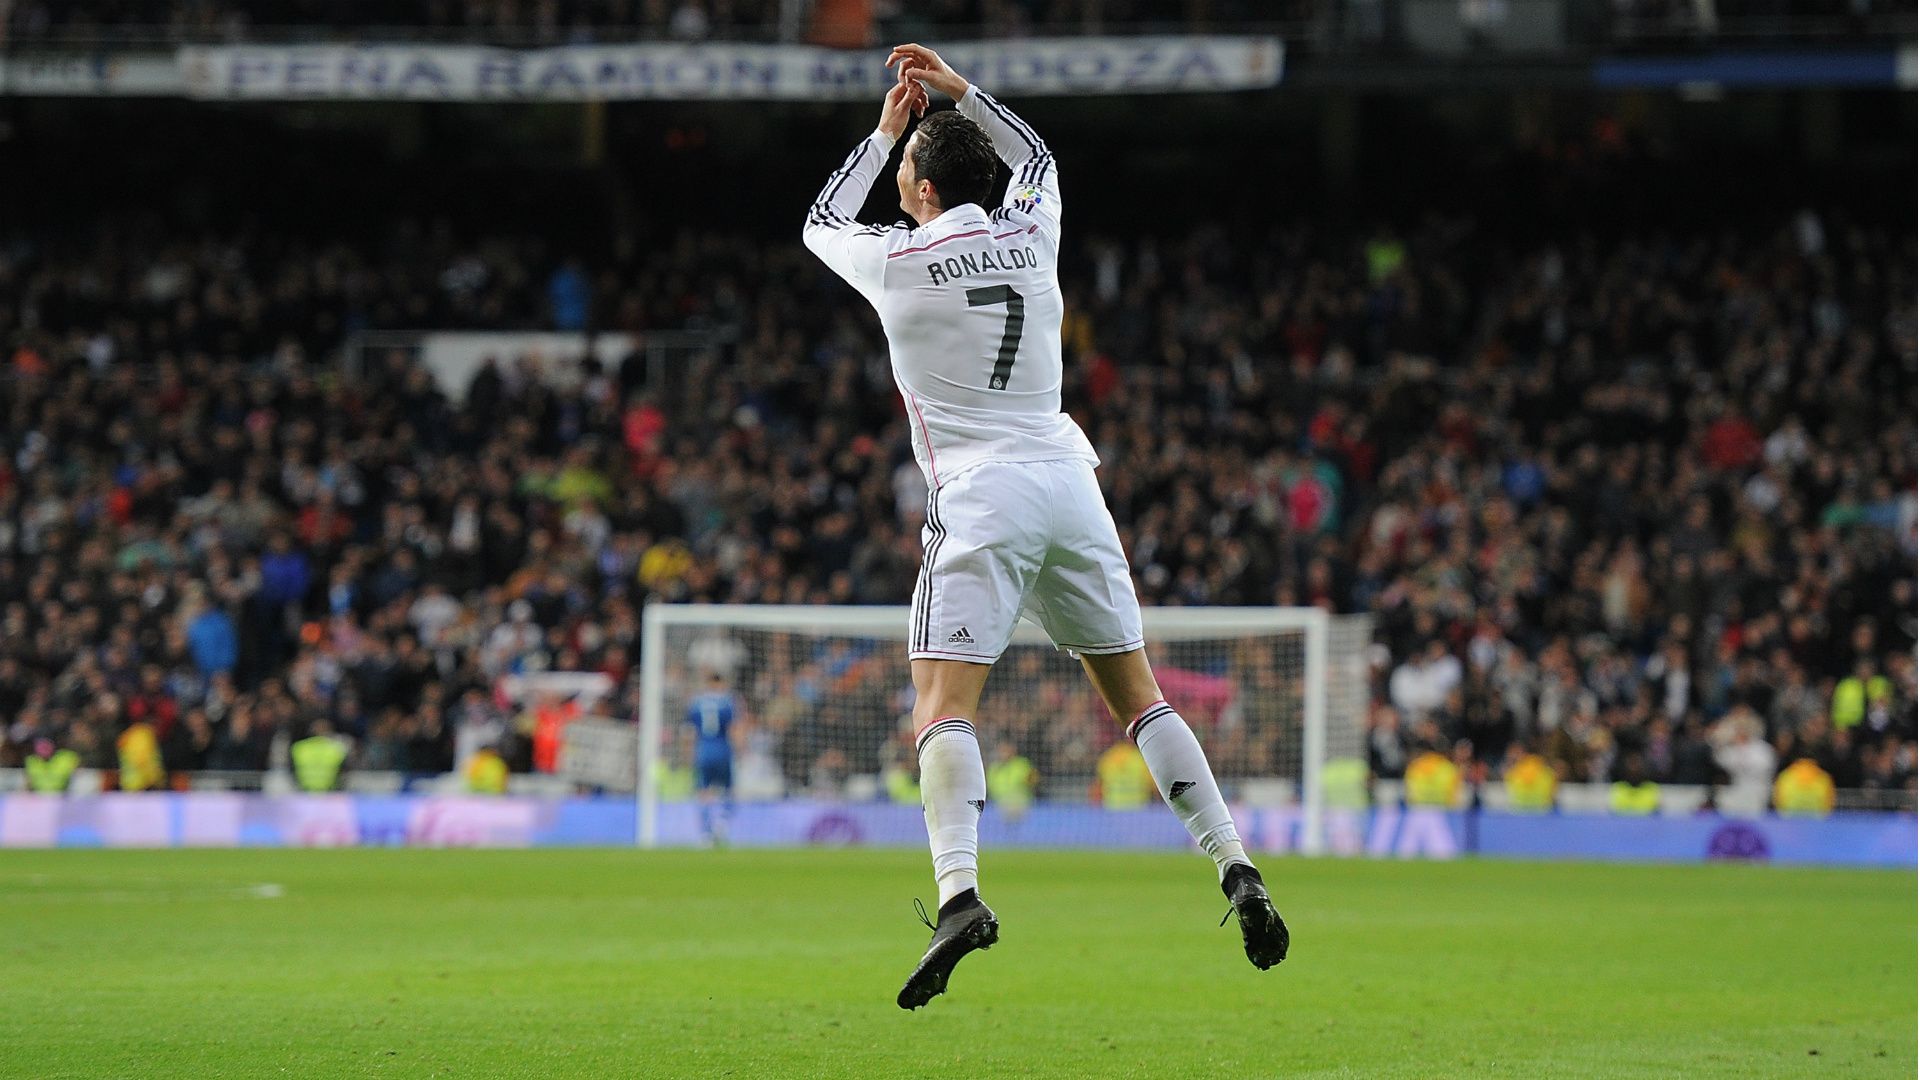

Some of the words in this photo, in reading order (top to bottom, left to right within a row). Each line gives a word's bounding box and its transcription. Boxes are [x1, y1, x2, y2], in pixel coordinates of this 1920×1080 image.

[927, 247, 1037, 286] RONALDO
[965, 283, 1025, 391] 7
[948, 636, 975, 644] adidas
